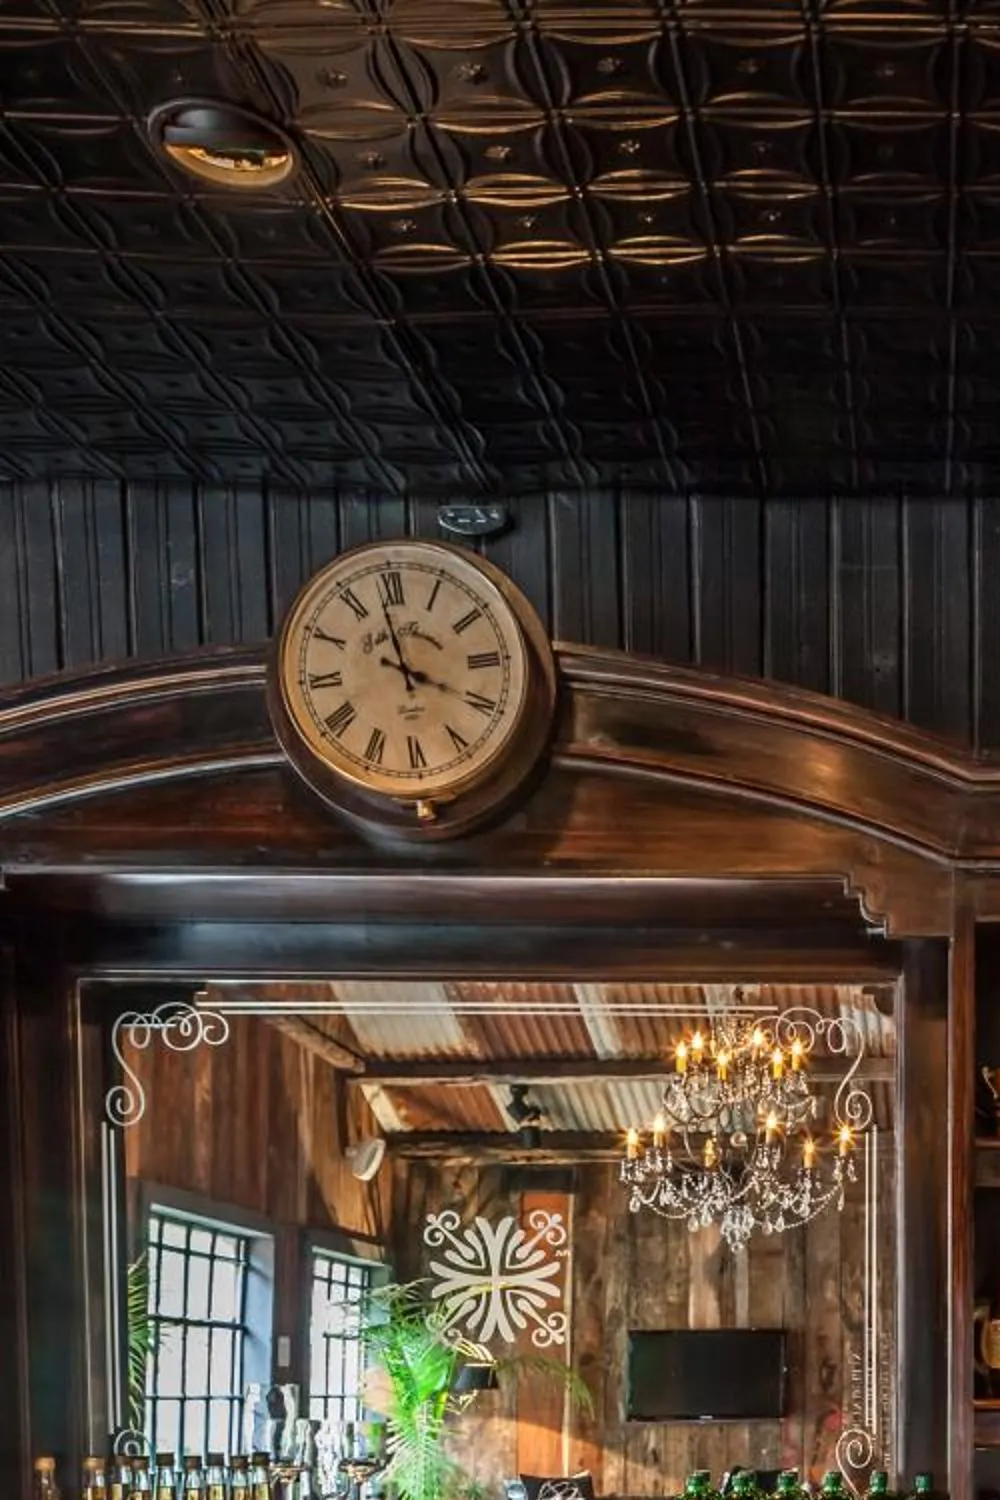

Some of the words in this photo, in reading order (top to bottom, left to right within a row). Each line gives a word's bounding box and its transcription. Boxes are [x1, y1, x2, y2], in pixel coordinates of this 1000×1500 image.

[339, 587, 369, 622] XI
[381, 571, 405, 606] XII
[427, 579, 442, 611] I
[453, 607, 483, 635] II
[313, 625, 347, 651] X
[467, 651, 501, 669] III
[307, 671, 342, 690] IX
[323, 700, 357, 738] VIII
[364, 727, 387, 764] VII
[407, 735, 428, 768] VI
[445, 722, 470, 753] V
